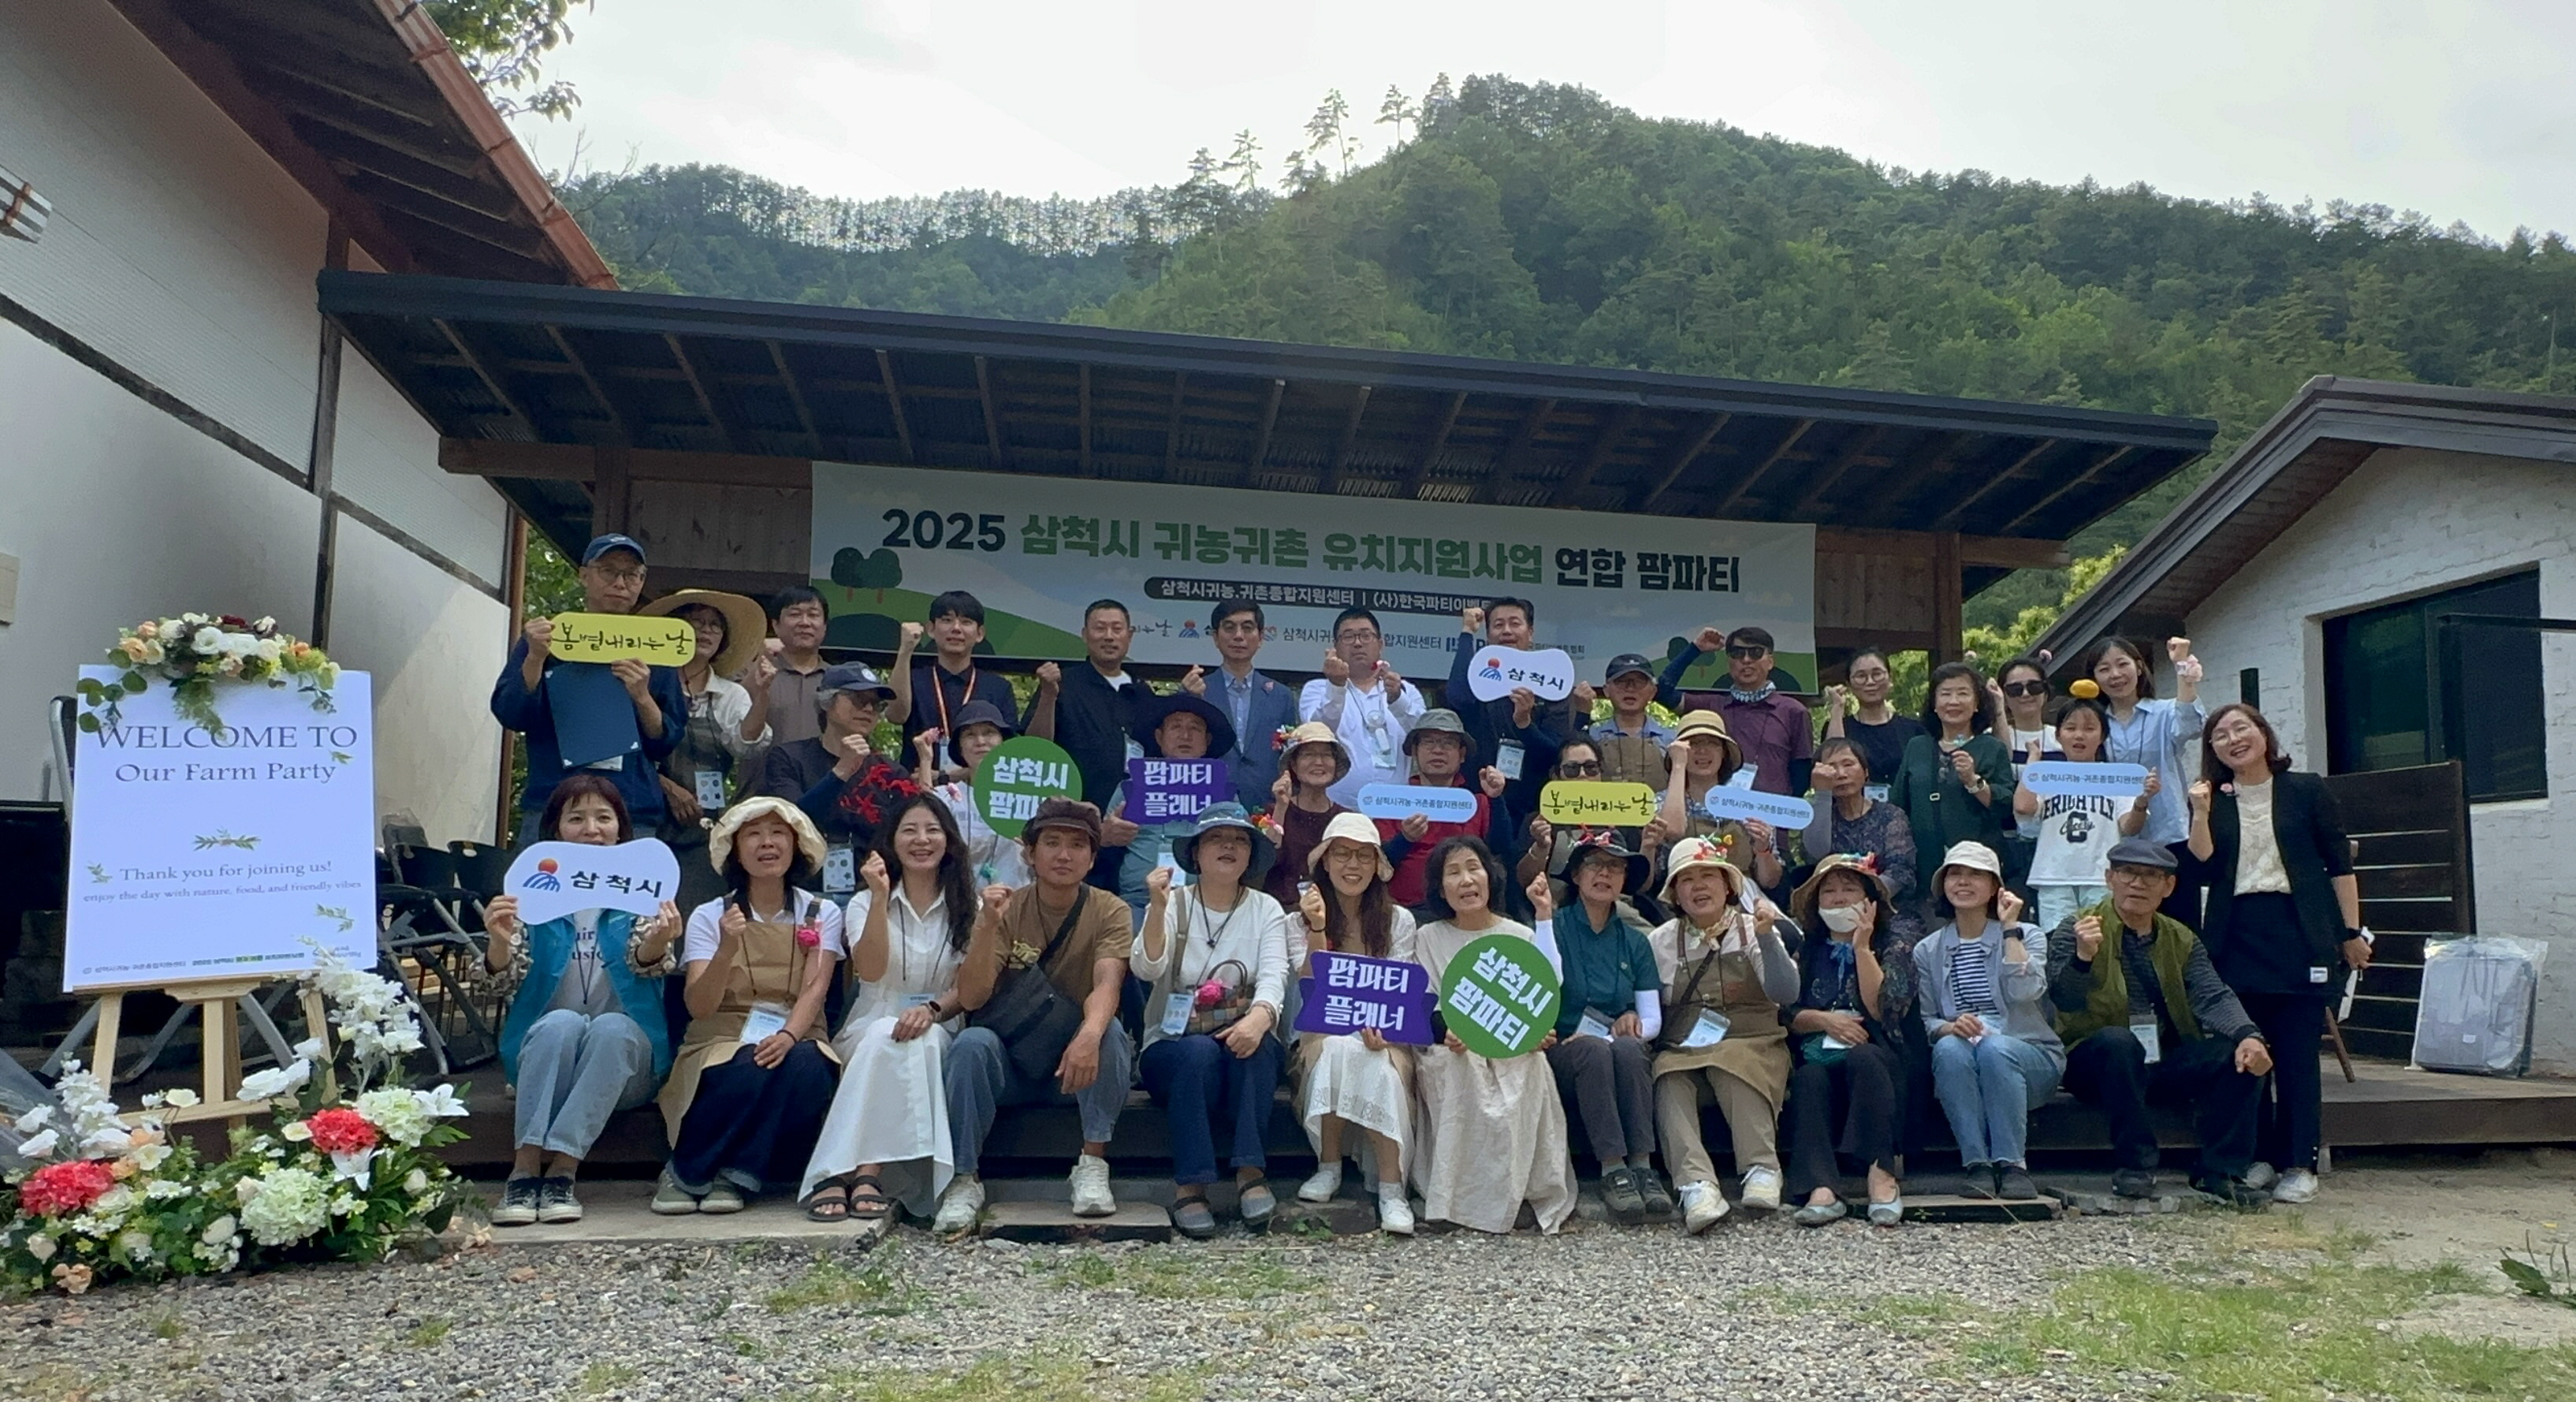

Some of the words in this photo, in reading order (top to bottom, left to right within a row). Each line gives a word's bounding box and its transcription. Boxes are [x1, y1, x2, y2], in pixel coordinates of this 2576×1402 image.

[882, 509, 1006, 551] 2025
[1021, 513, 1140, 558] 삼척시
[1153, 521, 1308, 569] 귀농귀촌
[1323, 531, 1543, 584] 유치지원사업
[1554, 546, 1625, 589] 연합
[1636, 551, 1740, 593] 팜파티
[1508, 667, 1564, 691] 삼척시
[98, 725, 297, 748] WELCOME
[307, 726, 357, 748] TO
[115, 764, 176, 782] Our
[184, 763, 257, 781] Farm
[267, 763, 337, 784] Party
[992, 755, 1069, 790] 삼척시
[1144, 761, 1212, 786] 팜파티
[988, 791, 1051, 822] 팜파
[119, 867, 178, 882] Thank
[181, 869, 214, 882] you
[219, 864, 244, 877] for
[247, 862, 305, 879] joining
[309, 860, 332, 873] us!
[570, 870, 662, 898] 삼척시
[83, 893, 116, 903] enjoy
[119, 889, 138, 900] the
[140, 889, 161, 900] day
[164, 888, 190, 898] with
[268, 883, 288, 893] and
[291, 881, 332, 893] friendly
[335, 880, 362, 889] vibes
[1327, 956, 1409, 994] 팜파티
[1472, 946, 1554, 1018] 삼척시
[1324, 994, 1405, 1031] 플래너
[1449, 976, 1531, 1051] 팜파티
